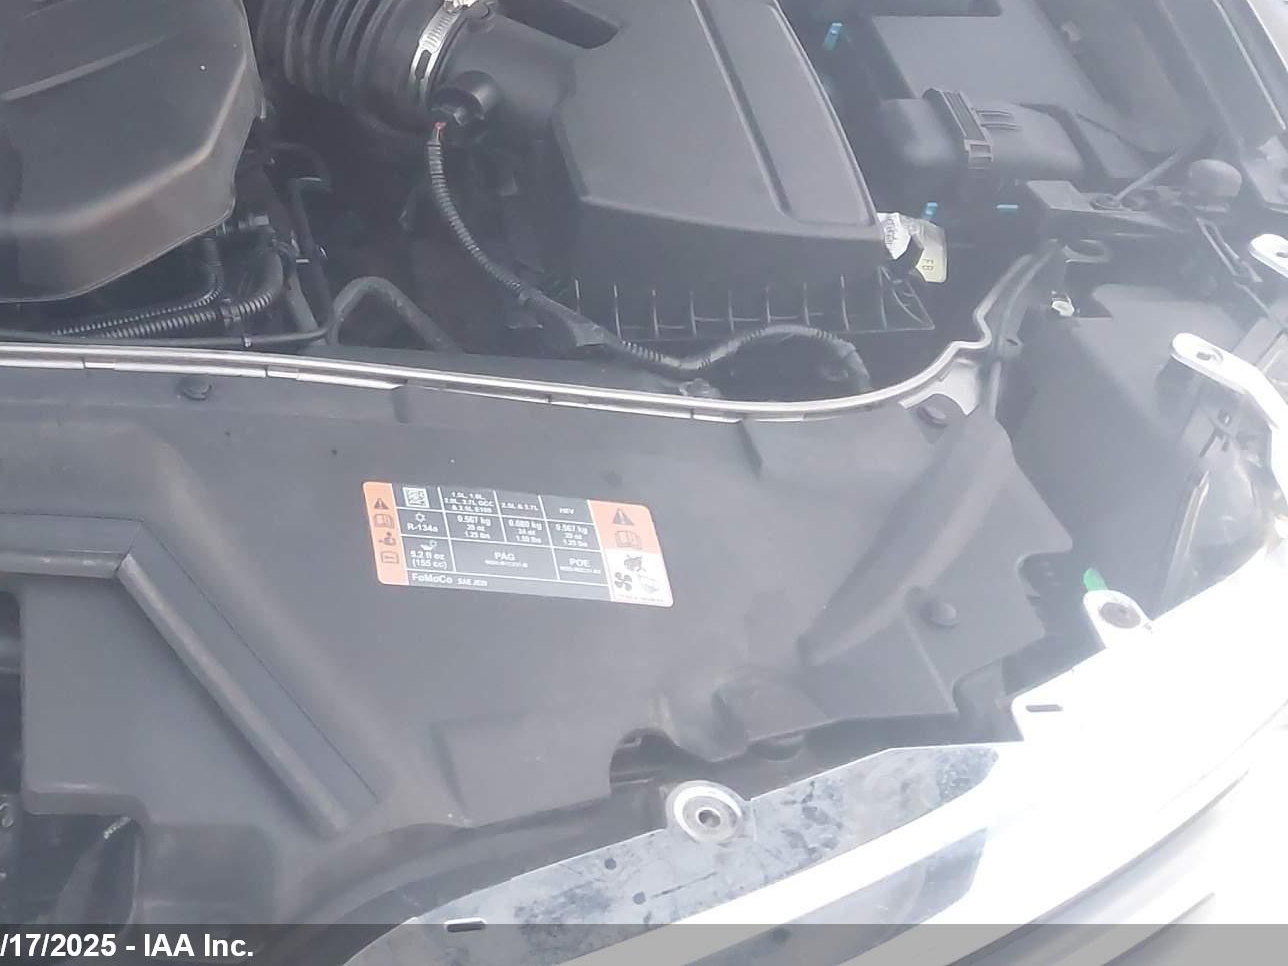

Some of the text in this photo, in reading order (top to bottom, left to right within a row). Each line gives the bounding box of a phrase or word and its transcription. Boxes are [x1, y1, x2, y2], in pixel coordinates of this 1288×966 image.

[480, 516, 491, 527] kg
[531, 520, 542, 531] kg
[407, 523, 438, 532] R-134a
[577, 524, 588, 535] kg
[410, 550, 424, 558] 5.2
[425, 551, 432, 559] fl
[494, 551, 516, 561] PAG
[412, 559, 447, 570] (155 cc)
[569, 557, 591, 567] POE
[412, 573, 453, 584] FoMoCo
